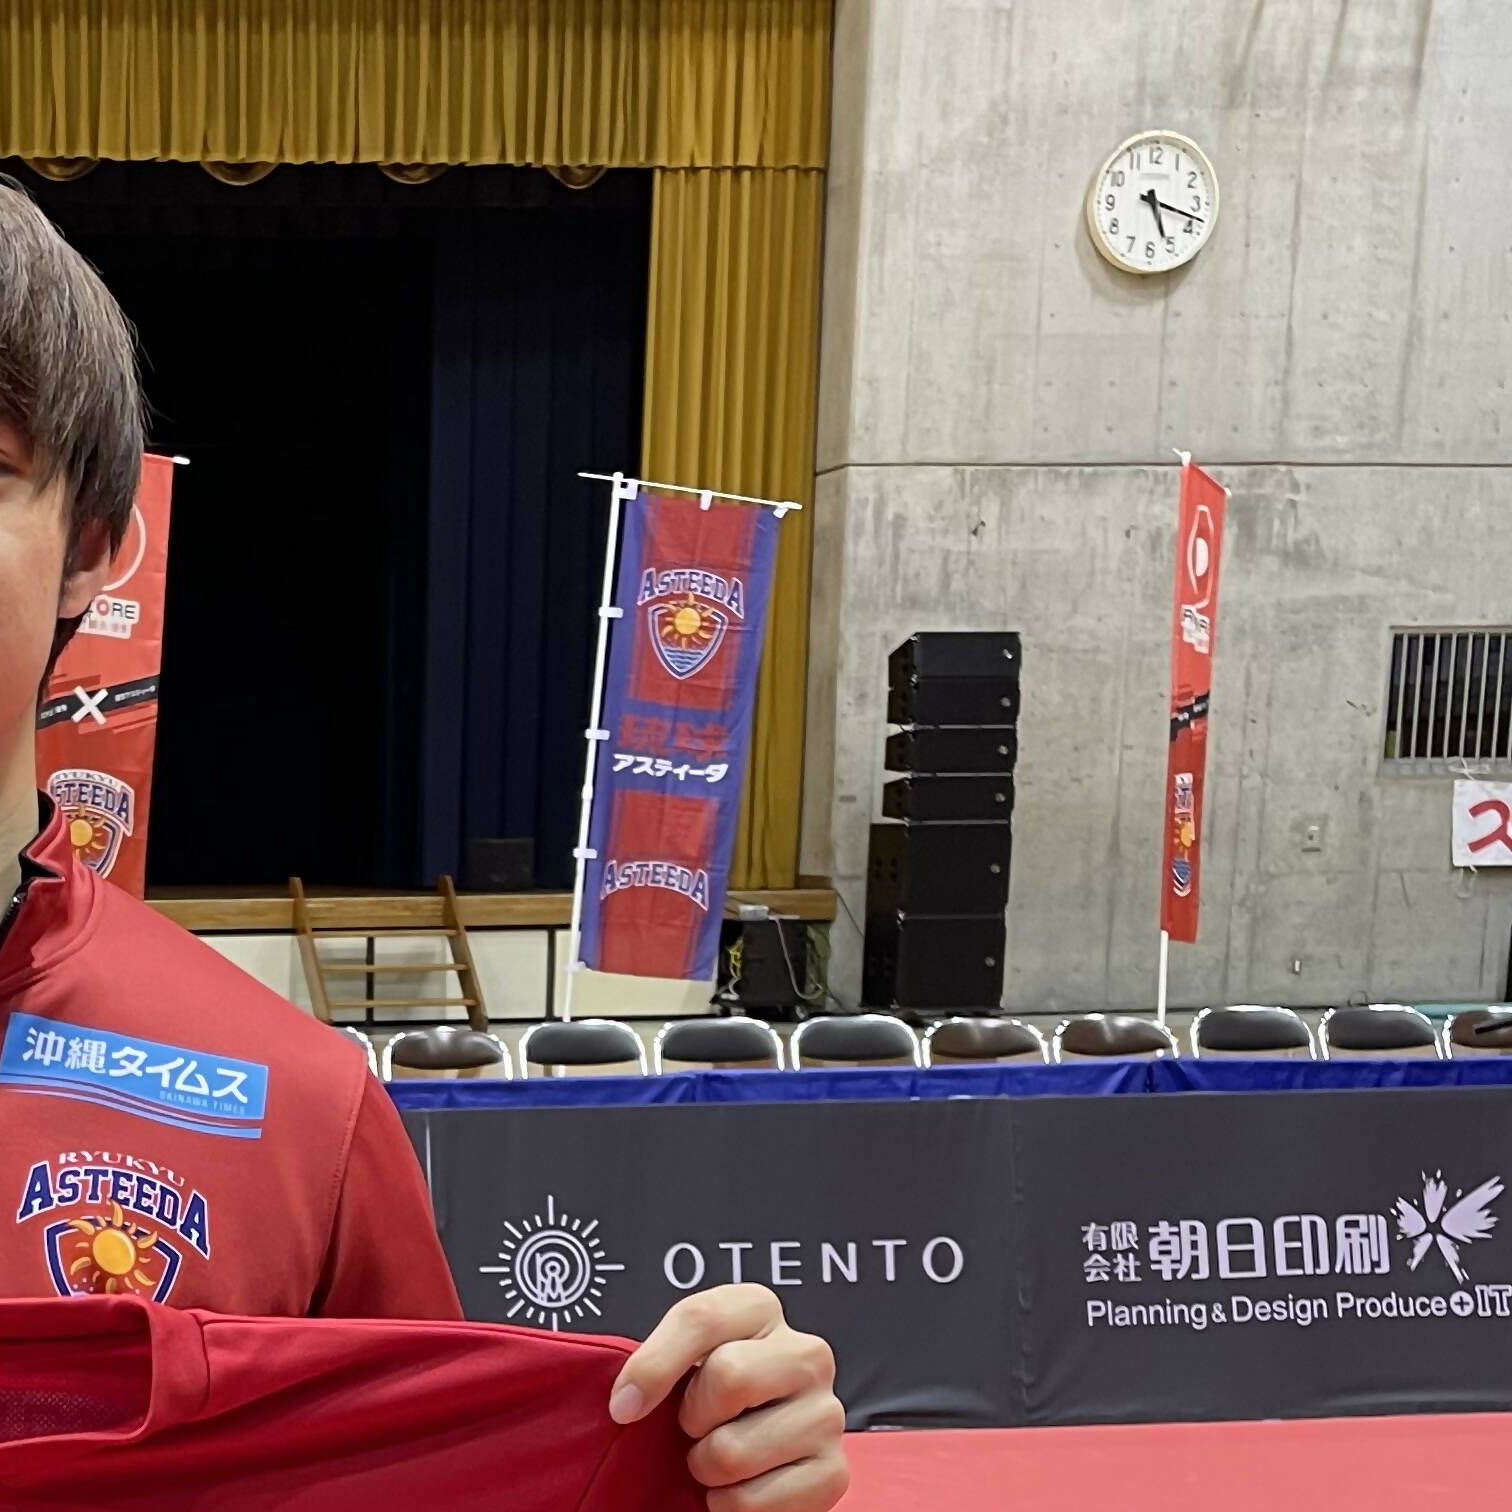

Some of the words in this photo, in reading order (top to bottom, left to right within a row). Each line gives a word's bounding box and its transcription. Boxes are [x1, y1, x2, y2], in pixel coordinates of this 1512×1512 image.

[1149, 147, 1164, 165] 12
[1110, 171, 1125, 188] 10
[1187, 171, 1198, 189] 2
[1105, 194, 1116, 211] 9
[1190, 195, 1201, 213] 3
[1109, 218, 1119, 236] 8
[1126, 236, 1136, 253] 7
[1145, 241, 1155, 259] 6
[637, 567, 745, 620] ASTEEDA
[612, 753, 729, 783] アスティータ
[599, 859, 709, 912] ASTEEDA
[22, 1027, 248, 1104] 沖縄タイムス
[59, 1150, 185, 1187] RYUKYU
[16, 1160, 210, 1260] ASTEEDA
[1081, 1220, 1139, 1252] 有限
[1148, 1214, 1390, 1282] 朝日印刷
[663, 1236, 964, 1290] OTENTO
[1083, 1254, 1142, 1282] 会社
